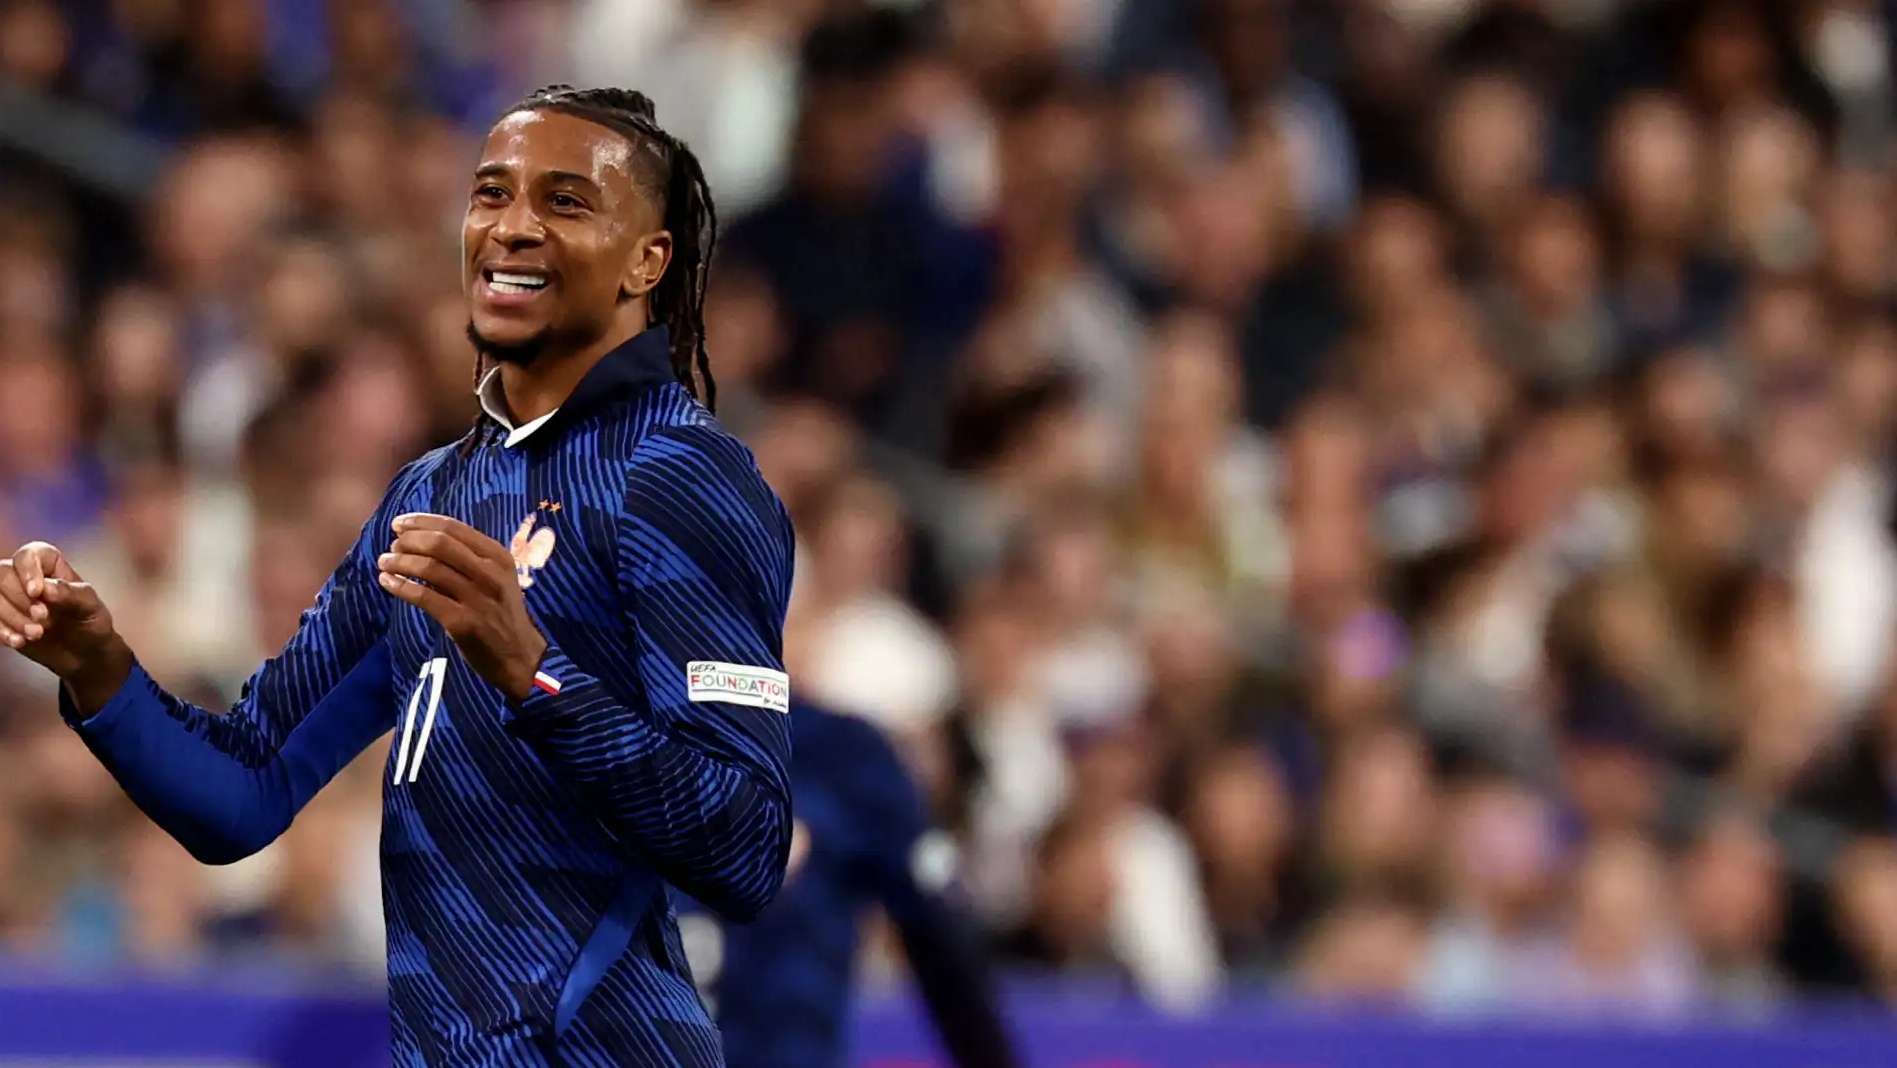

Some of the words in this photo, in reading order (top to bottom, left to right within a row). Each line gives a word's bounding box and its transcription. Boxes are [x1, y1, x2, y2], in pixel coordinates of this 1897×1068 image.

[690, 663, 717, 673] UEFA
[690, 674, 787, 698] FOUNDATION
[394, 657, 447, 785] 11
